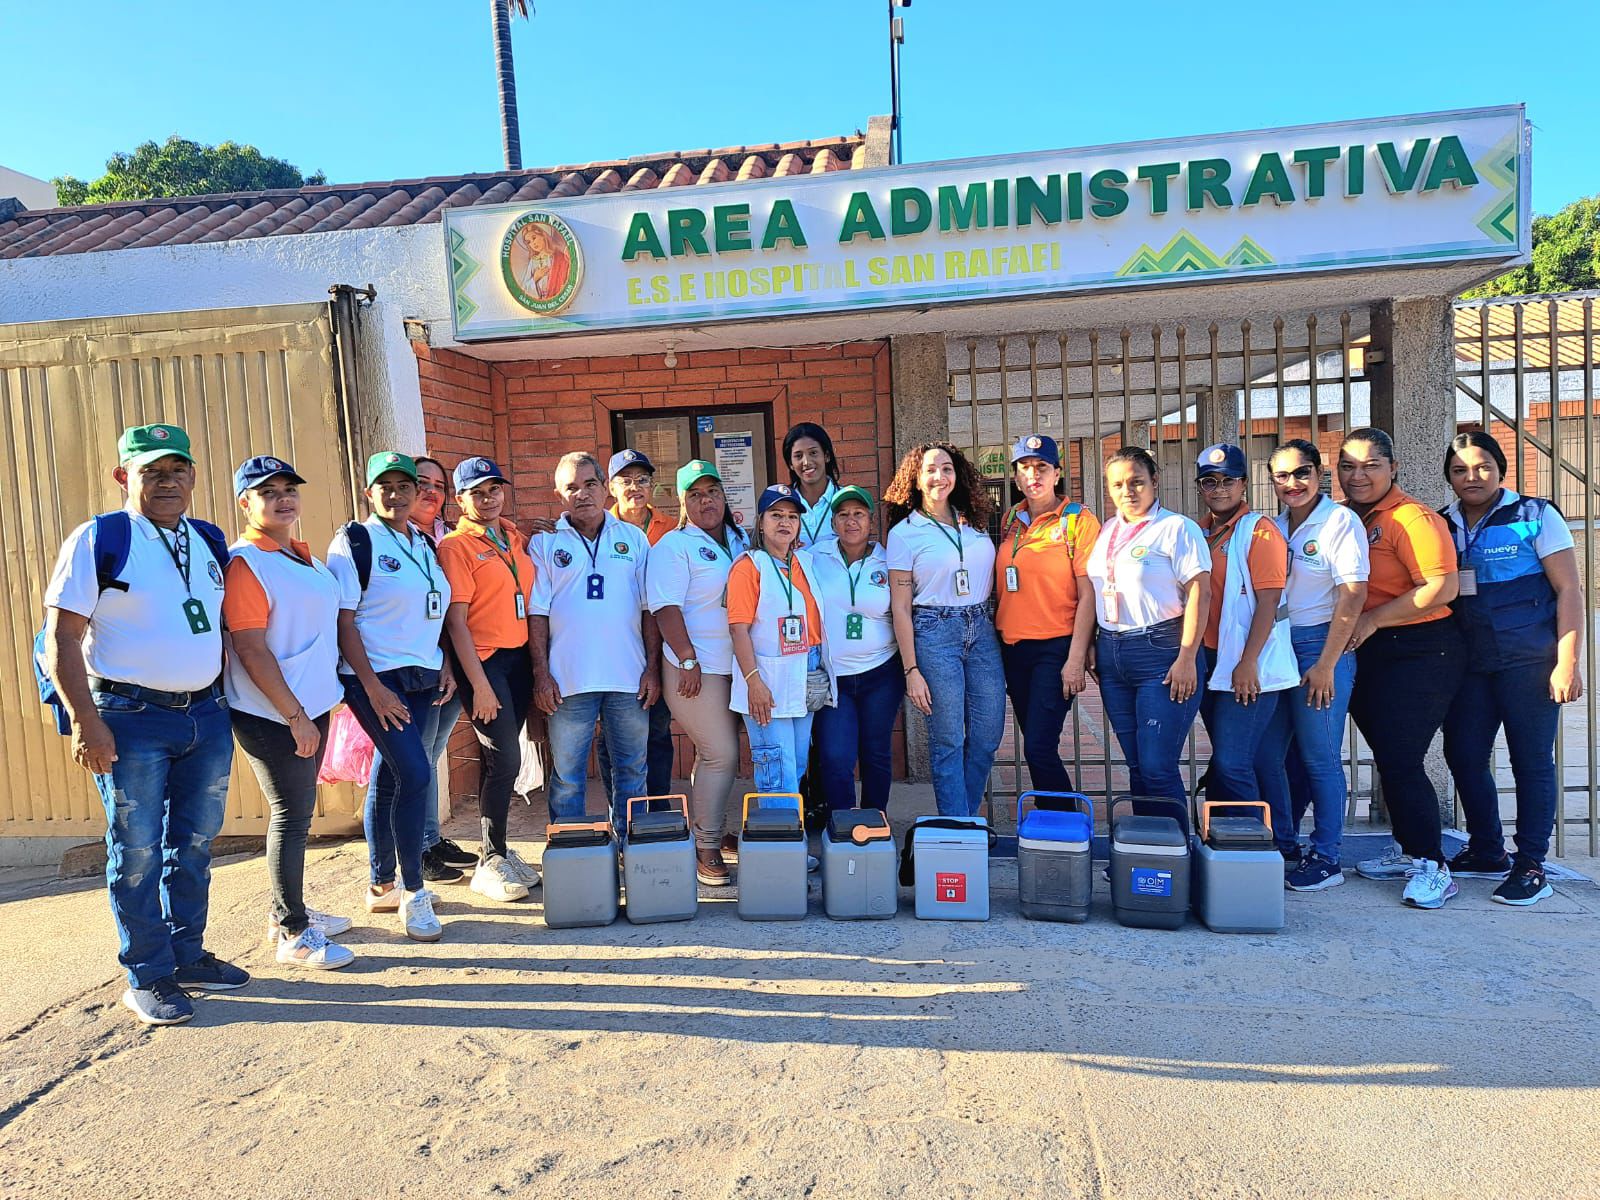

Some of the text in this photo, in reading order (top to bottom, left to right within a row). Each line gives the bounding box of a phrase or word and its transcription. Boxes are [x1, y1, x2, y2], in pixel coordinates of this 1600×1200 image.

[622, 134, 1480, 262] AREA ADMINISTRATIVA
[503, 214, 573, 257] HOSPITAL SAN RAFAEL
[627, 273, 697, 304] E.S.E
[703, 260, 861, 299] HOSPITAL
[868, 252, 935, 286] SAN
[518, 294, 530, 306] SAN
[531, 301, 547, 309] JUAN
[547, 301, 559, 309] DEL
[1484, 545, 1518, 554] nueva
